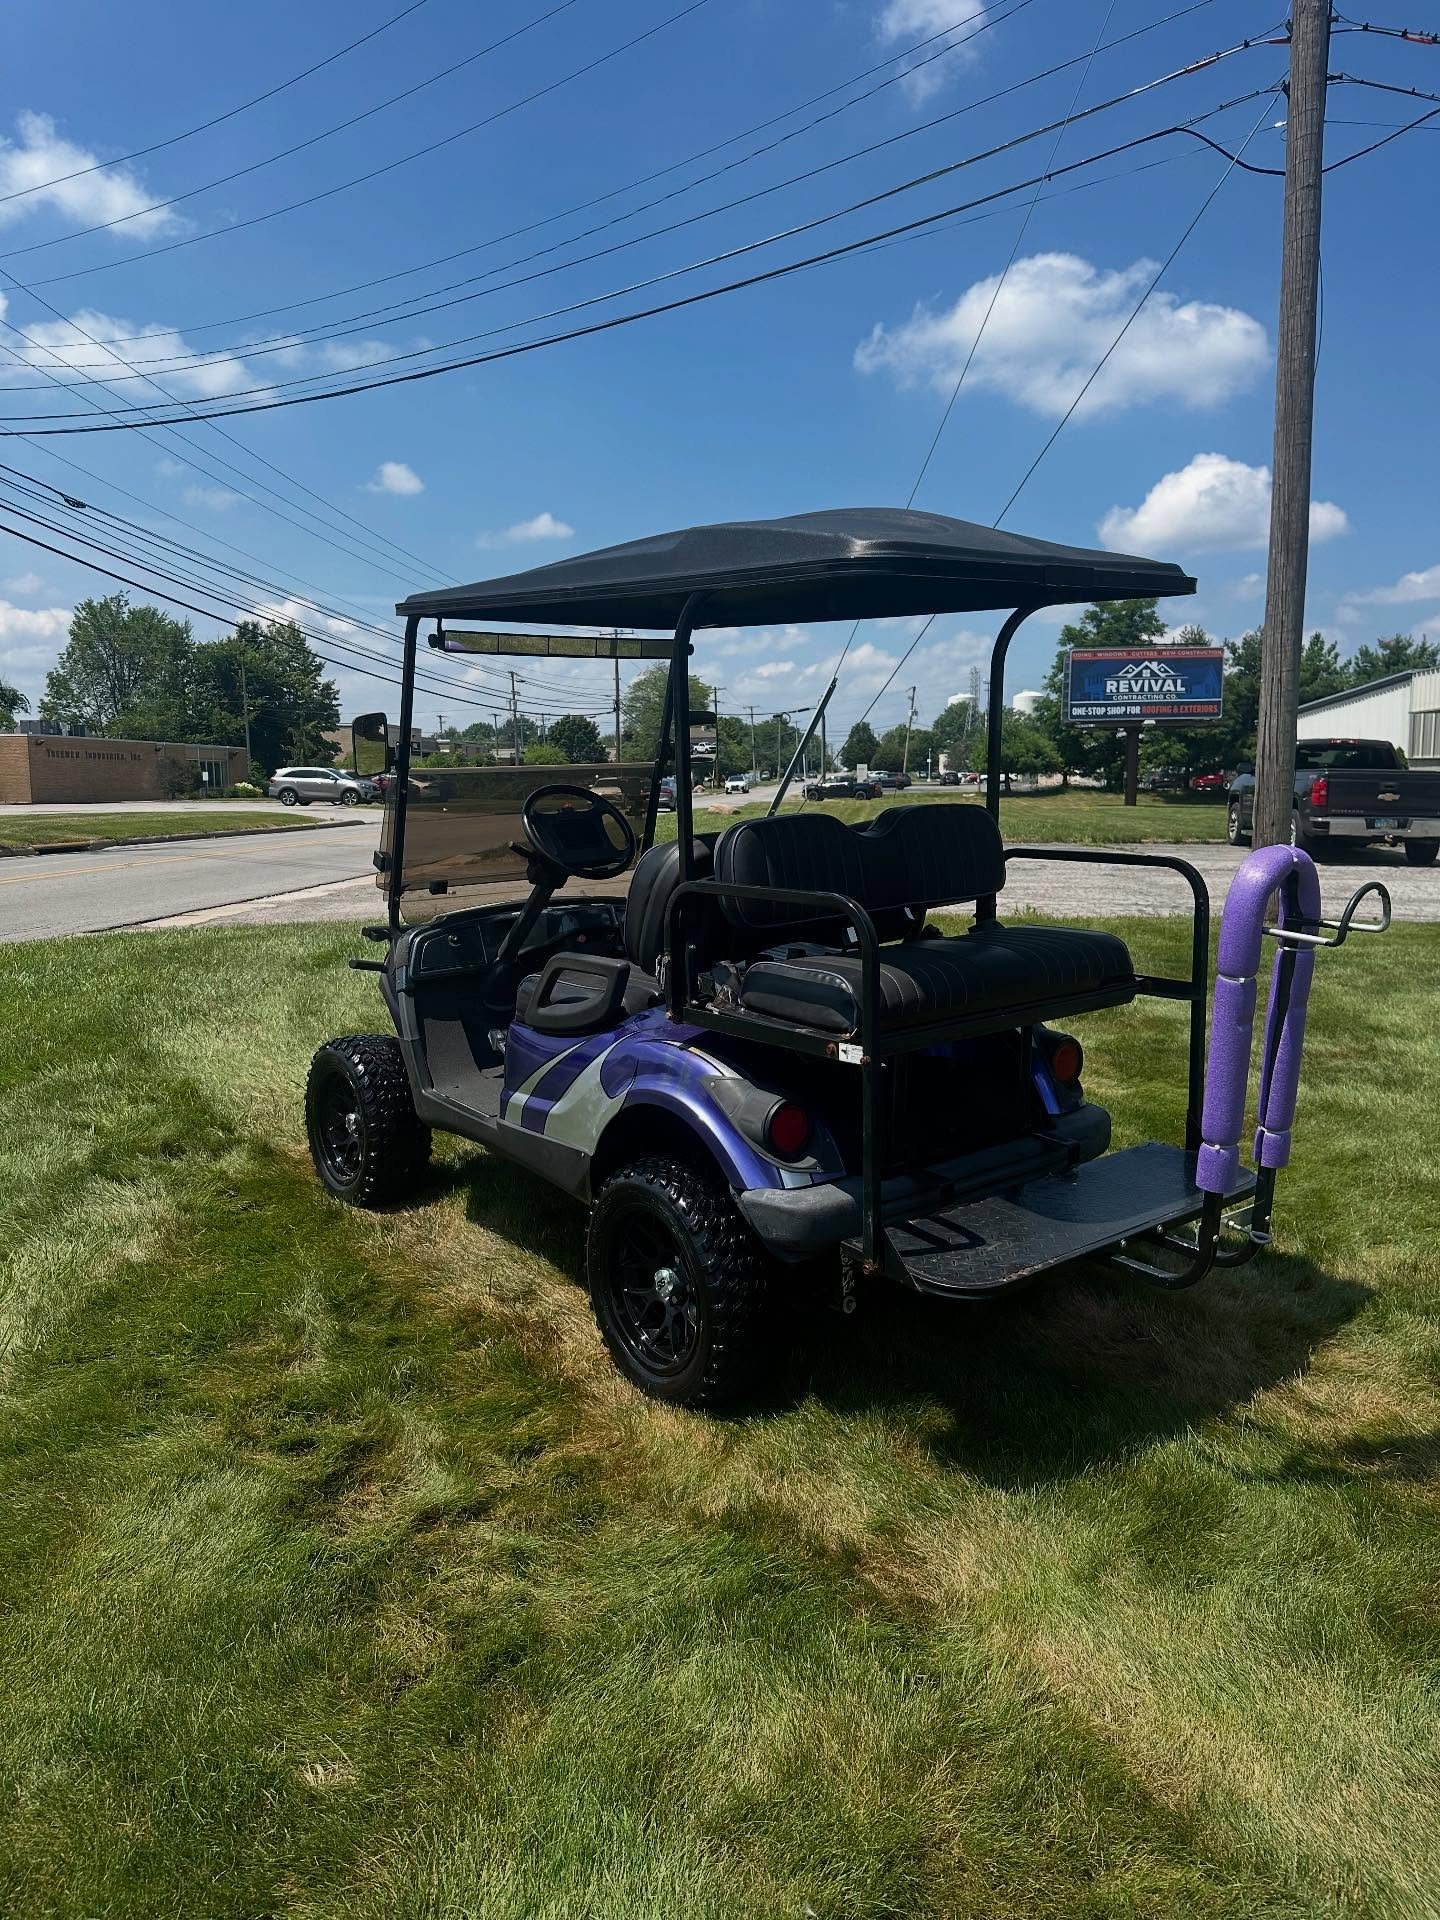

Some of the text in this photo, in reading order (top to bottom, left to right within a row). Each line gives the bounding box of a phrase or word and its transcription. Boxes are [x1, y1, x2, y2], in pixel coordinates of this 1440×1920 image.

[1106, 679, 1186, 693] REVIVAL
[1072, 704, 1218, 716] ONE-STOP SHOP FOR ROOFING & EXTERIORS
